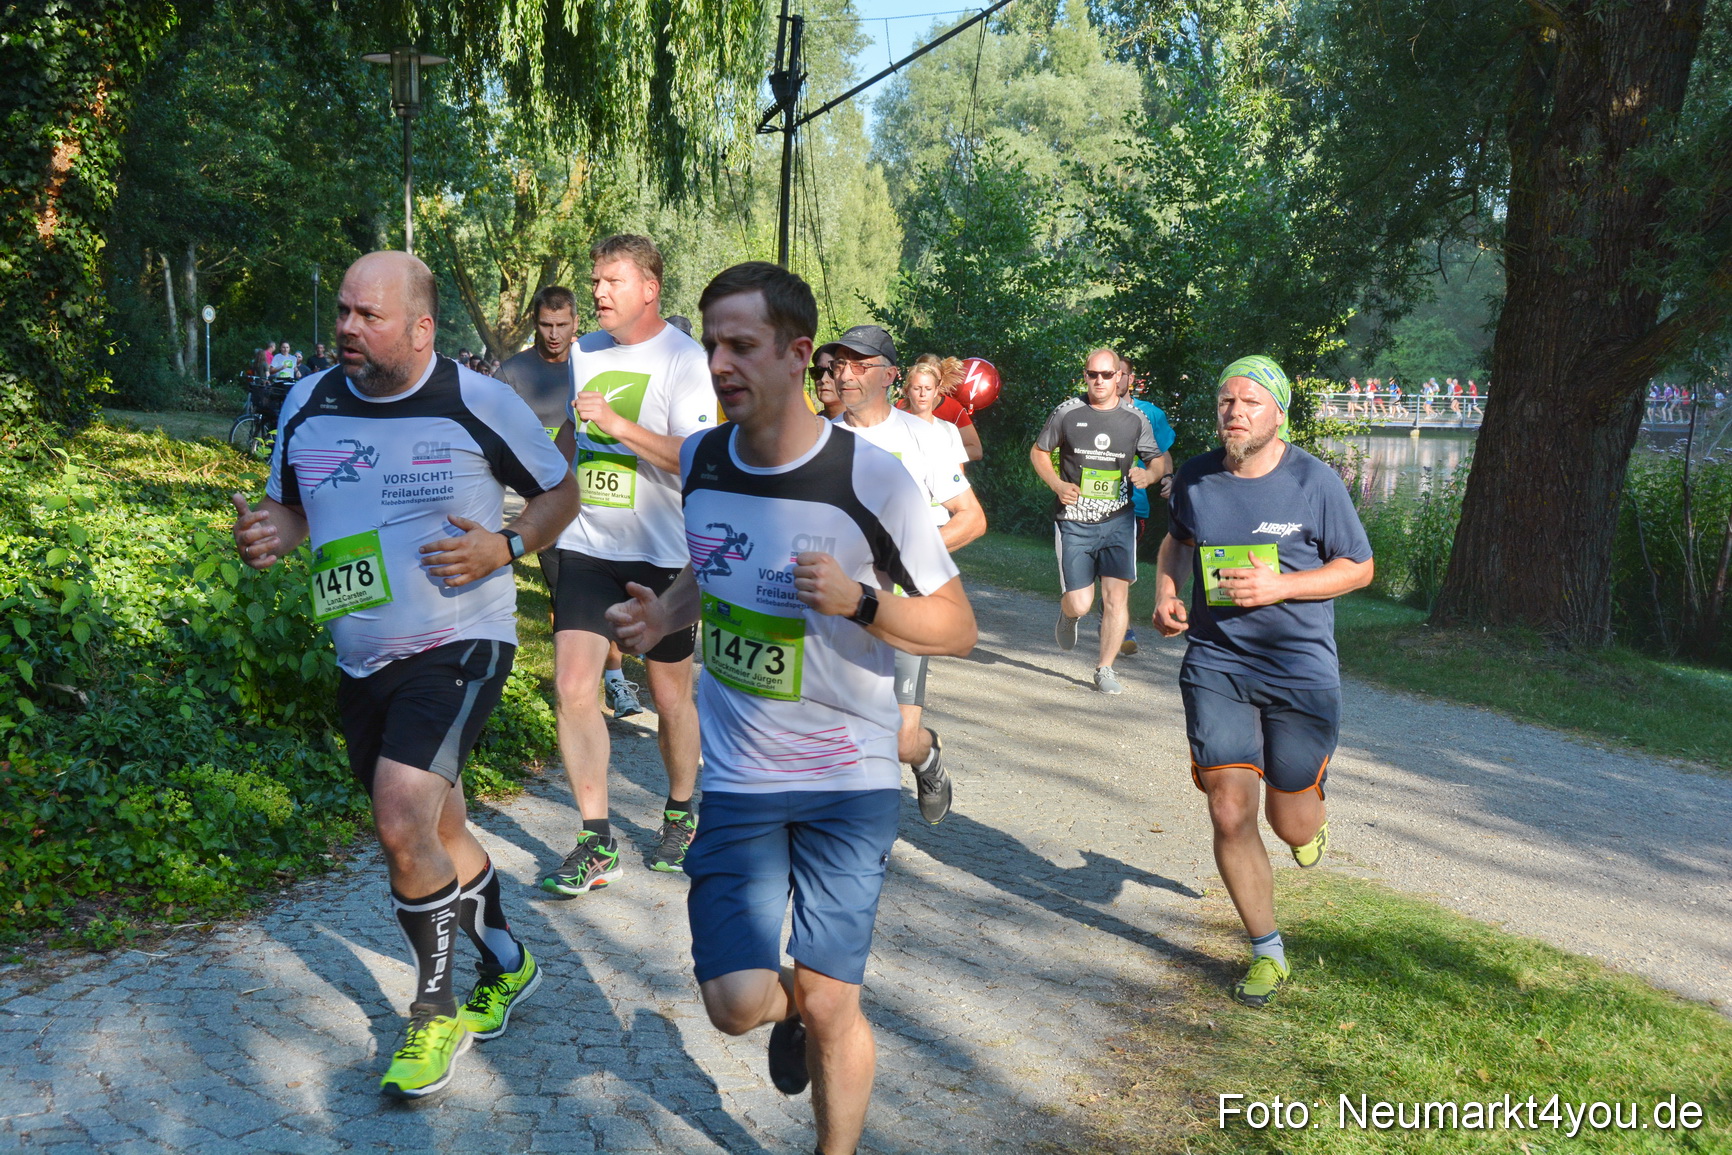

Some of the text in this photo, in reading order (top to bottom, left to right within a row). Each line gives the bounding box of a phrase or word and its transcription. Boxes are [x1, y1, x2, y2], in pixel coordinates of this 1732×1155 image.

[383, 470, 453, 485] VORSICHT!
[586, 469, 619, 492] 156
[1093, 480, 1109, 491] 66
[381, 485, 454, 499] Freilaufende
[316, 560, 375, 599] 1478
[758, 567, 793, 584] VORS
[326, 590, 368, 606] Lanz Carsten
[711, 628, 785, 675] 1473
[752, 672, 783, 685] Jürgen
